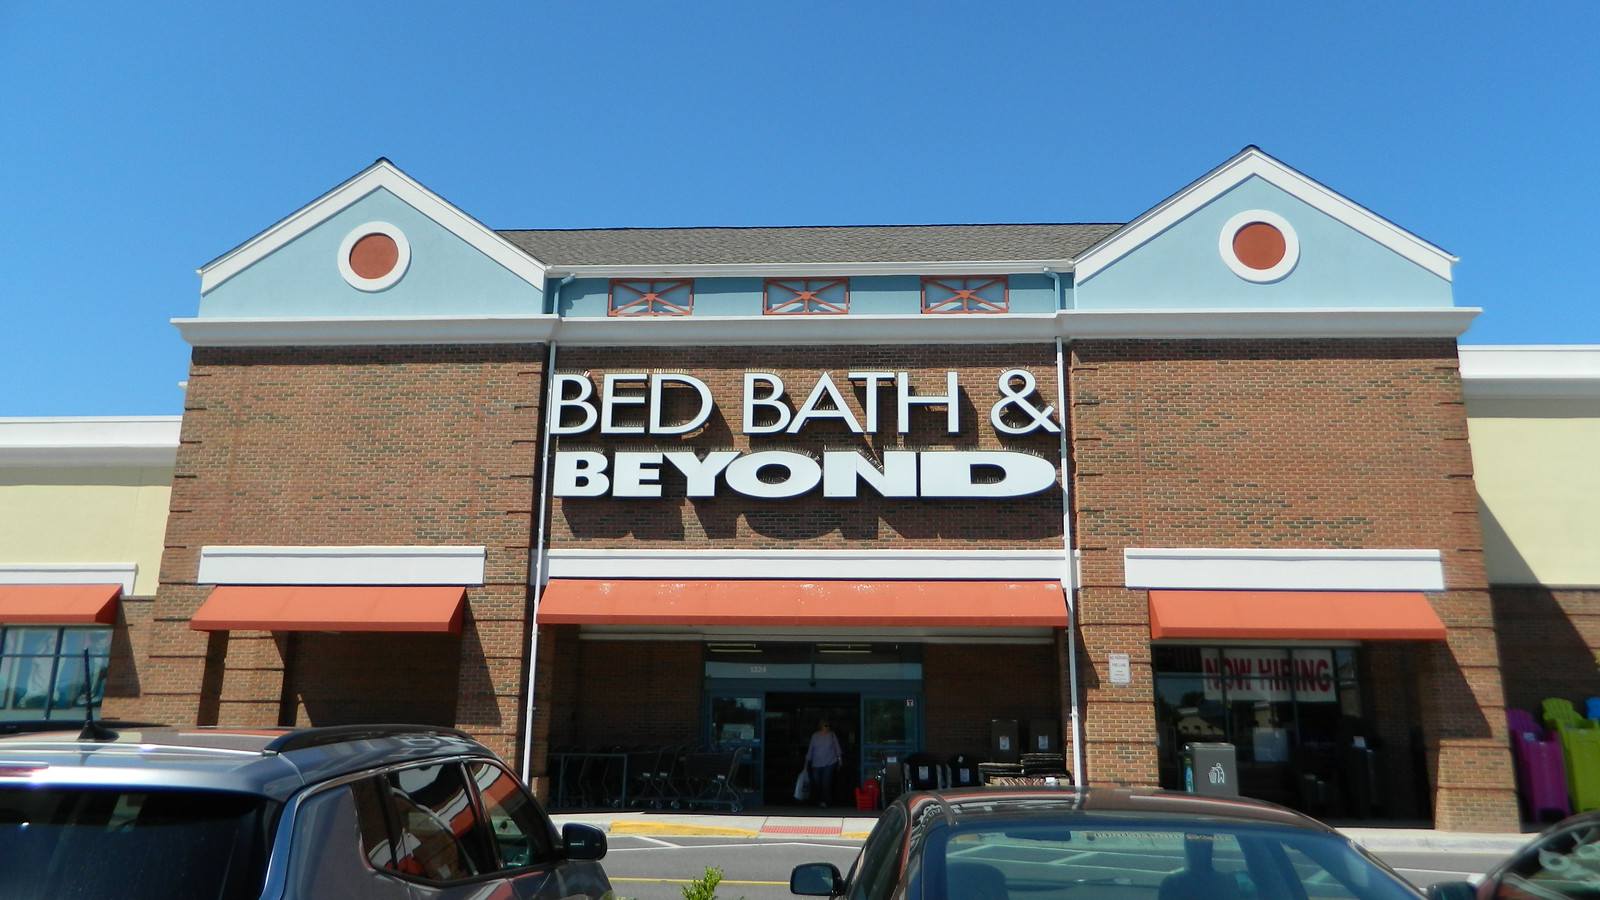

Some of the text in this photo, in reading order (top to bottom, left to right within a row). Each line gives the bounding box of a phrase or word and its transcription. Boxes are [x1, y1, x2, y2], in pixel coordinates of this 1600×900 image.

[549, 368, 1062, 435] BED BATH &
[552, 450, 1057, 499] BEYOND
[1204, 658, 1331, 692] NOW HIRING
